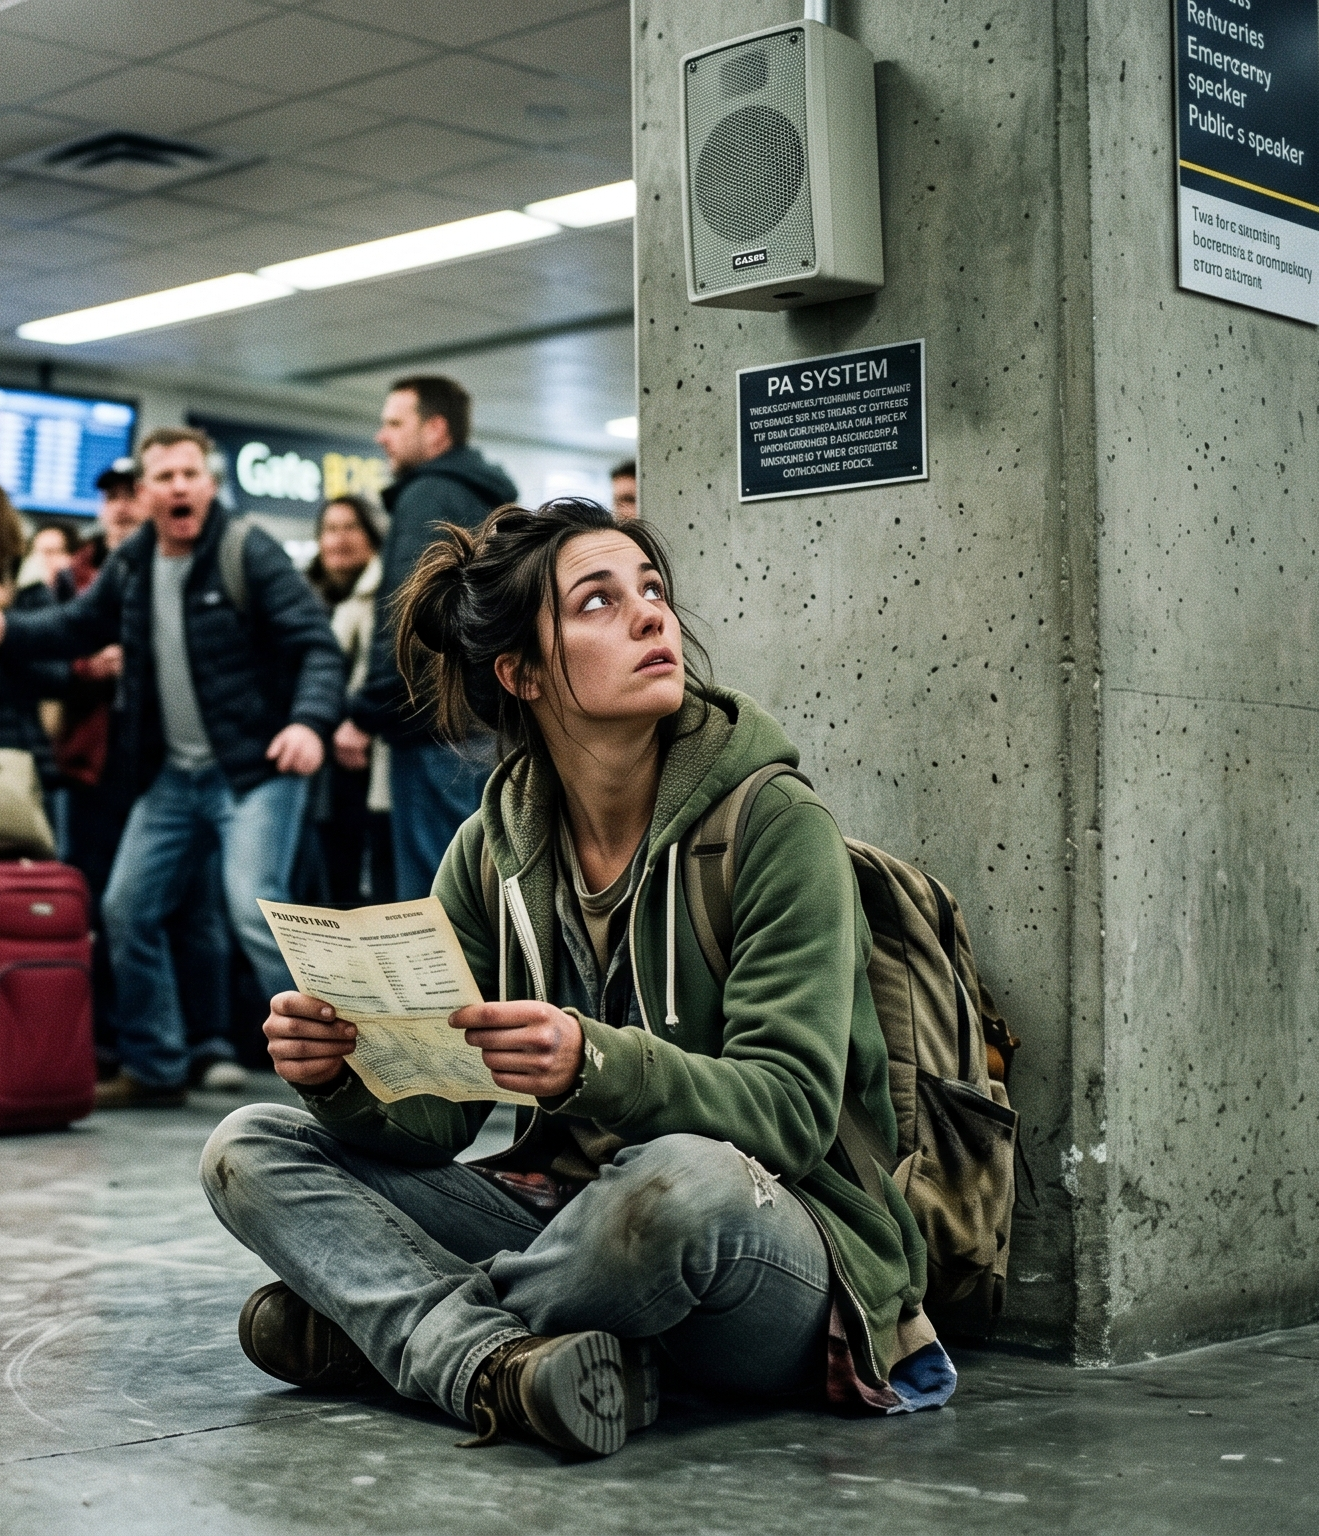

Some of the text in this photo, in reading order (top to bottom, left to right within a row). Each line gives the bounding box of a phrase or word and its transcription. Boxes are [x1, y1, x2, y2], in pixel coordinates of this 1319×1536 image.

[1189, 103, 1235, 141] Public
[768, 358, 888, 397] PA SYSTEM
[236, 441, 322, 502] Gate
